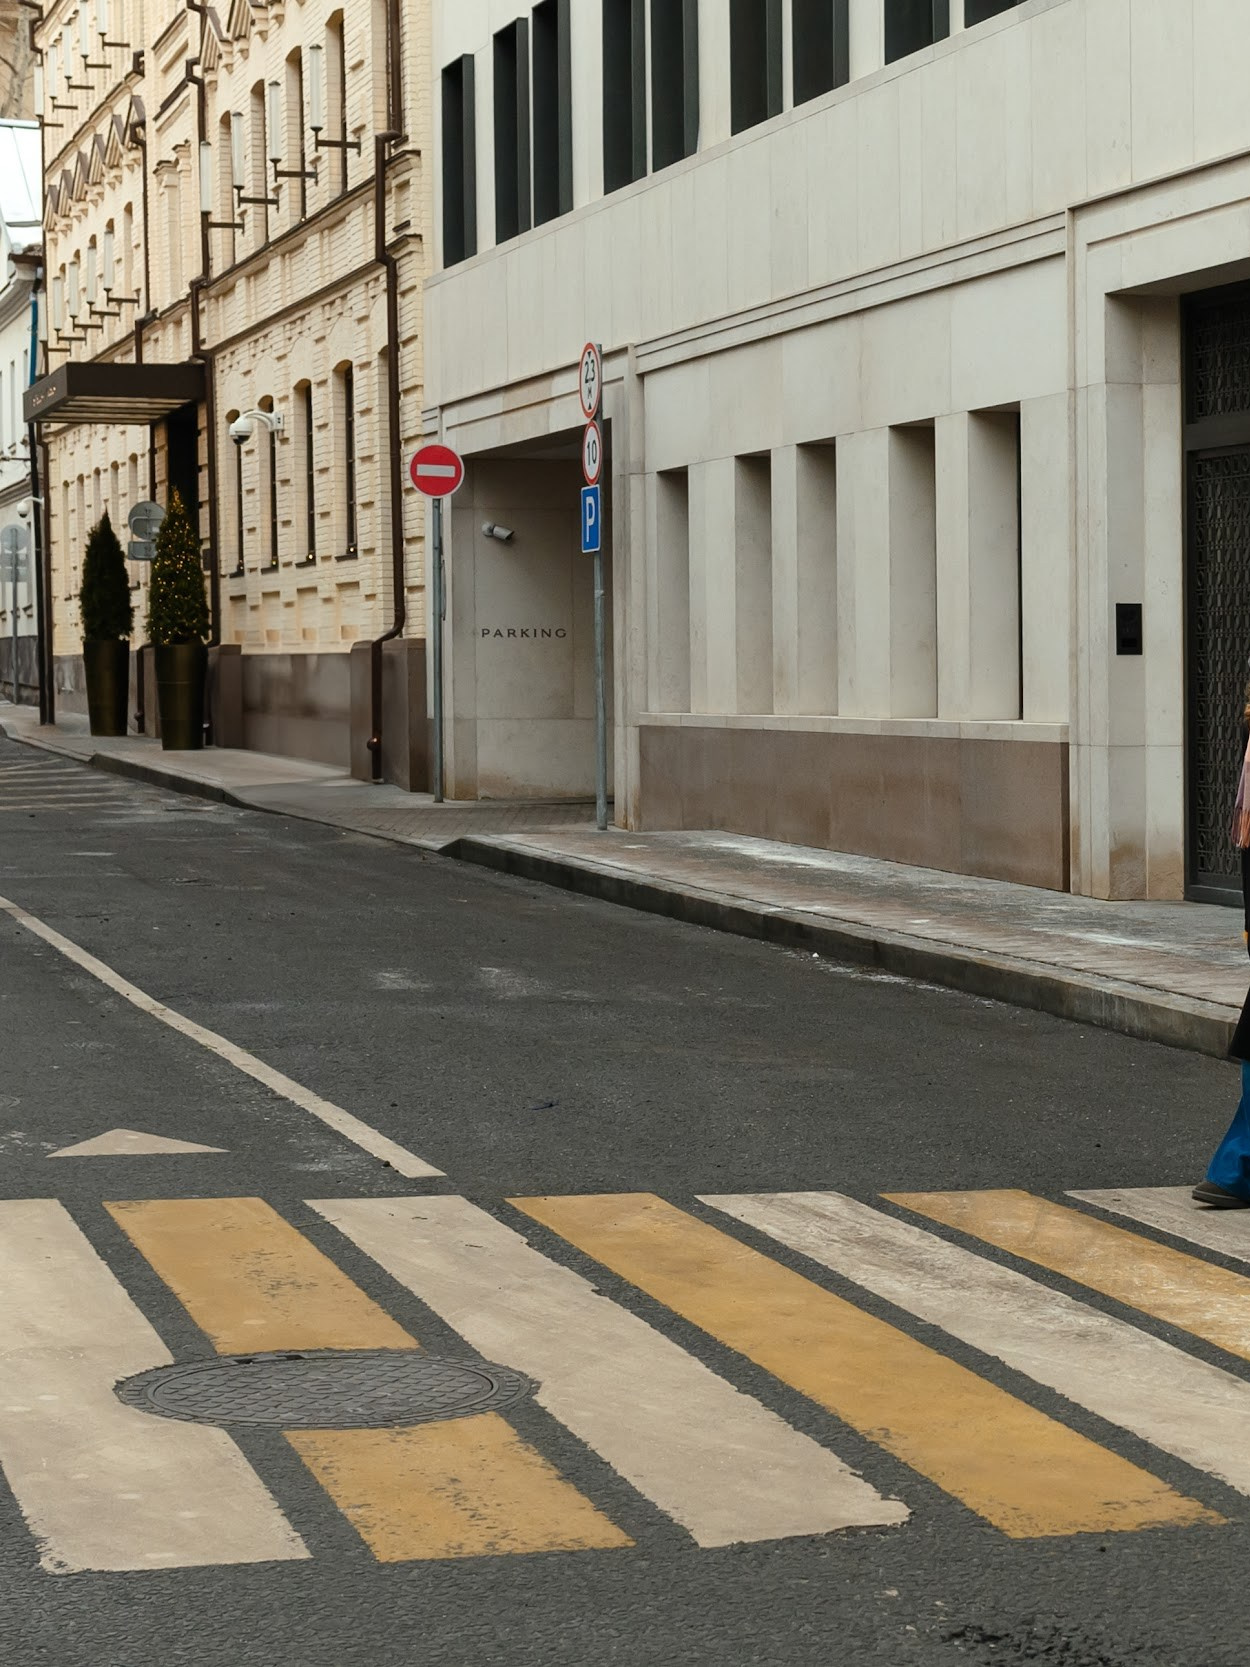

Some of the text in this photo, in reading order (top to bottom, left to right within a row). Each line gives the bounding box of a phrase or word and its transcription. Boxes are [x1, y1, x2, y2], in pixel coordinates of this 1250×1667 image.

[586, 440, 597, 465] 10
[586, 496, 595, 543] P
[481, 628, 567, 639] PARKING
